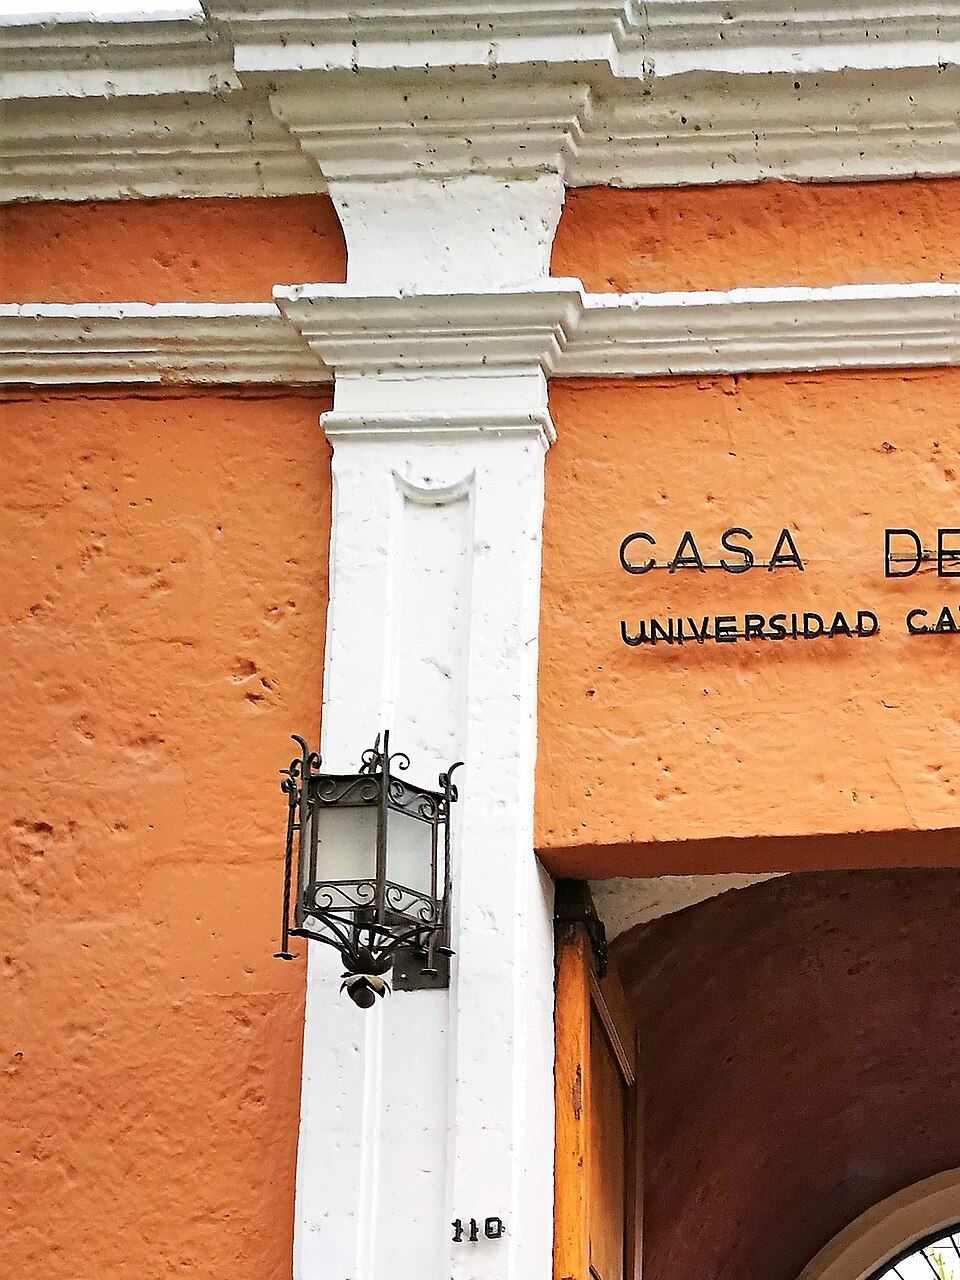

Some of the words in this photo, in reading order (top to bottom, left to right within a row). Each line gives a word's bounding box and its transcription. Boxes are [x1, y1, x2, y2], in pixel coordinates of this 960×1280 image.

[619, 528, 806, 575] CASA
[620, 609, 880, 647] UNIVERSIDAD
[451, 1216, 504, 1242] 110
